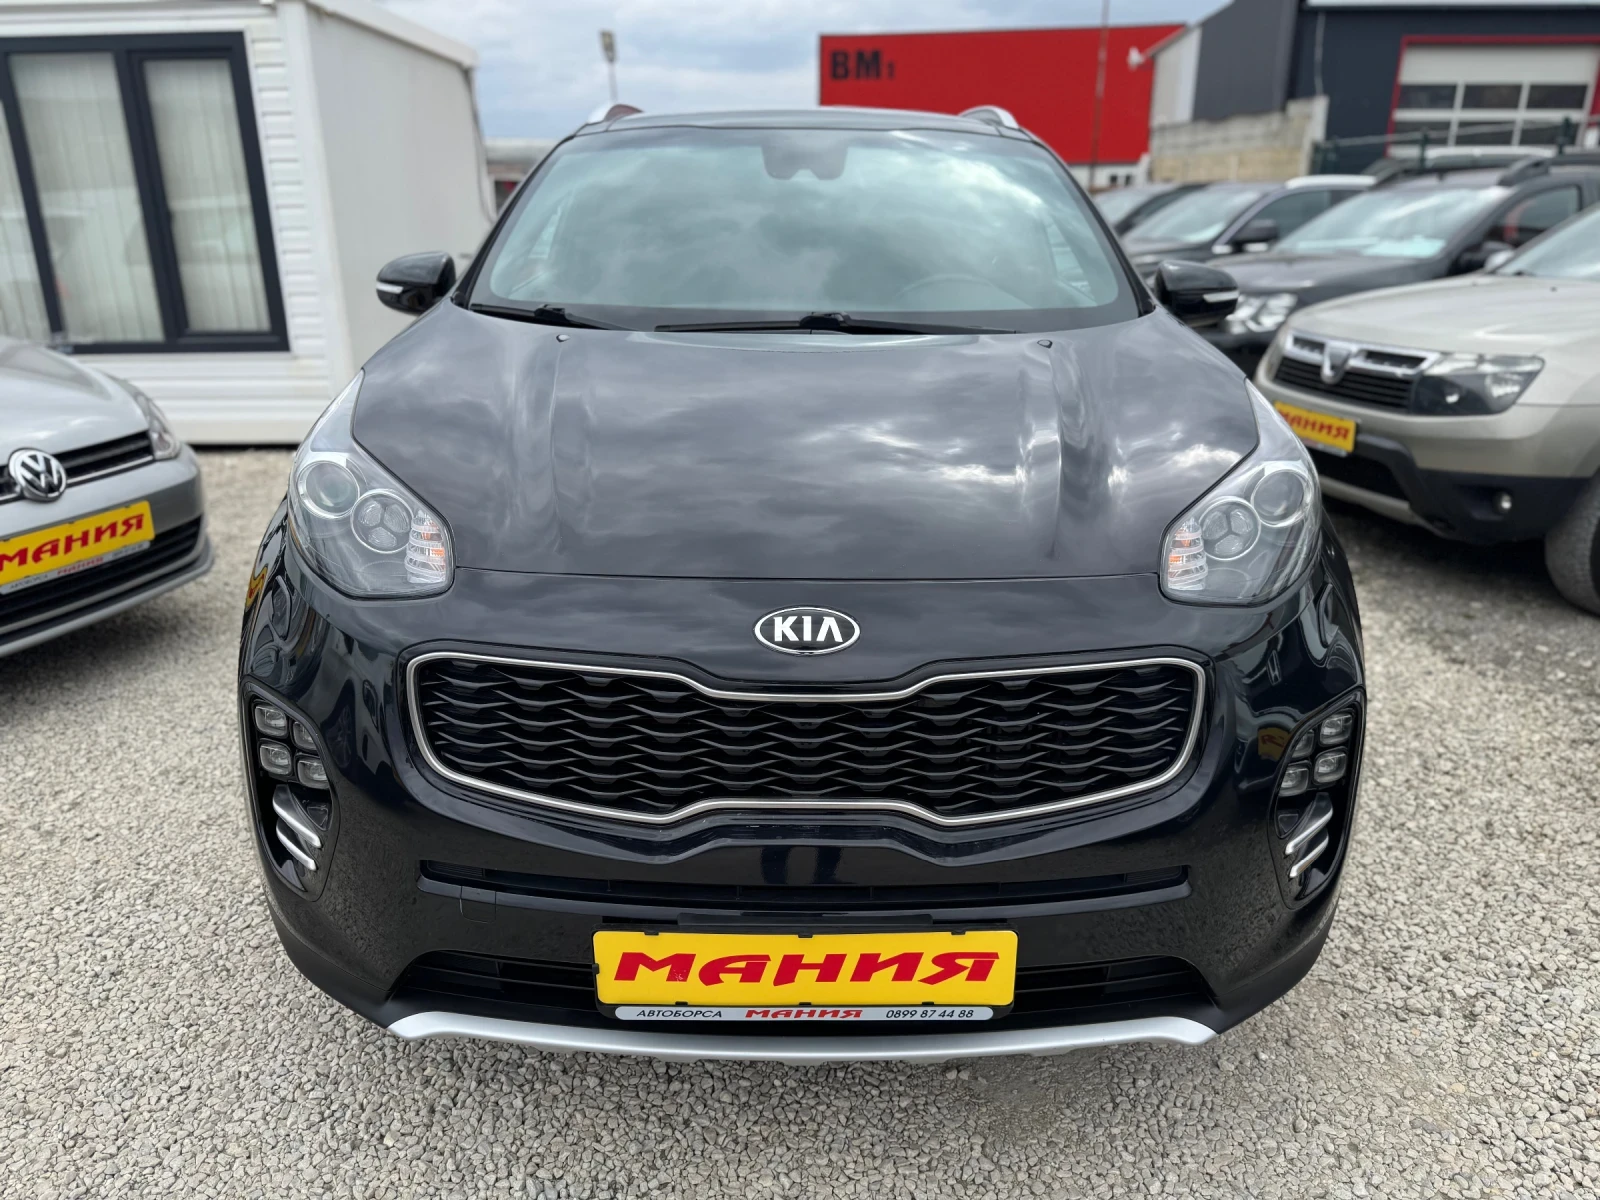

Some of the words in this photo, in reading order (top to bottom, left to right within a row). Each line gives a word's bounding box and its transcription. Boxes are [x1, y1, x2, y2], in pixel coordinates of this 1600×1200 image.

[773, 615, 844, 642] KIA
[614, 951, 1000, 987] МАНИЯ
[636, 1009, 723, 1019] АВТОБОРСА
[745, 1009, 863, 1019] МАНИЯ
[885, 1009, 918, 1019] 0899
[919, 1009, 937, 1019] 87
[937, 1009, 956, 1019] 44
[957, 1009, 975, 1019] 88
